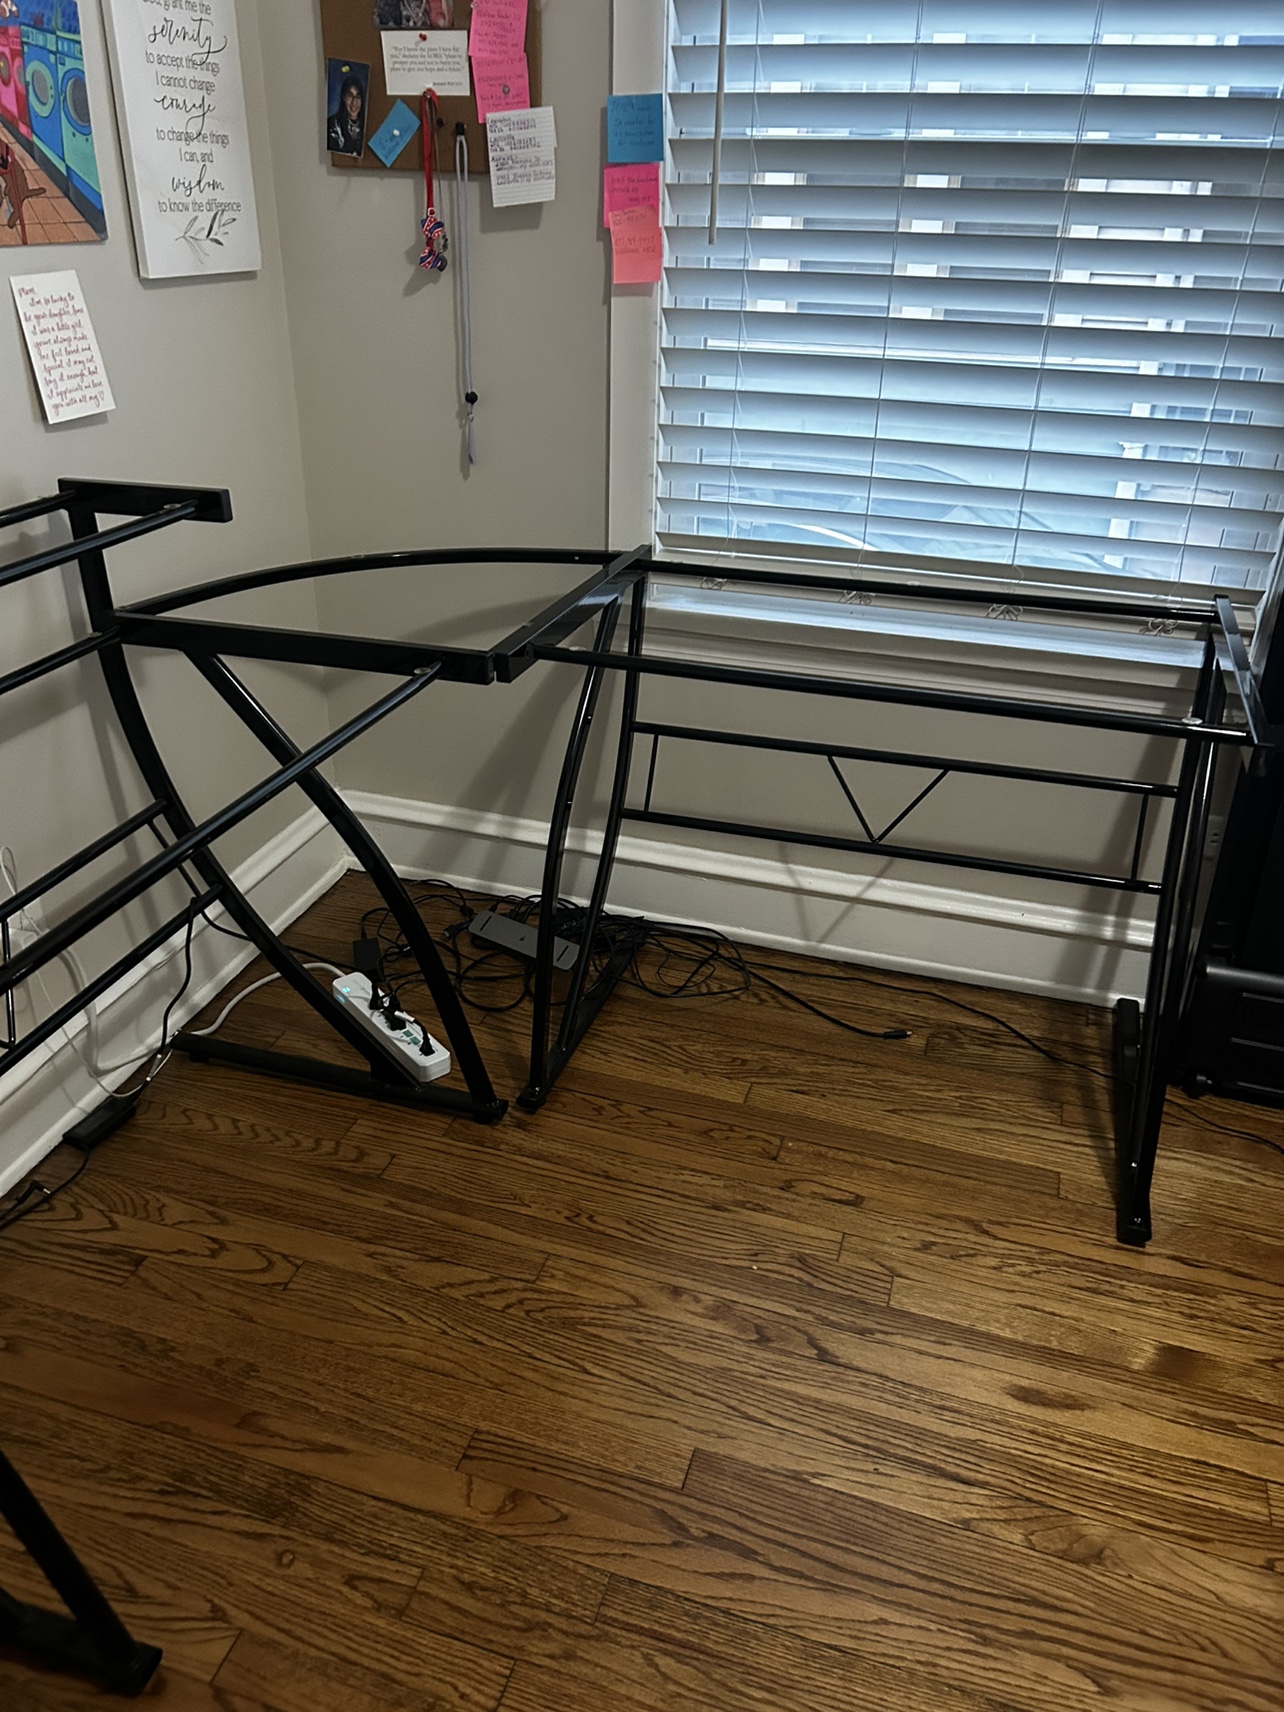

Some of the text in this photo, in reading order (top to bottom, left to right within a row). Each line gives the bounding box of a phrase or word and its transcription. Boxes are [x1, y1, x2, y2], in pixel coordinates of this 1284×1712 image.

[185, 1, 198, 13] me
[199, 2, 212, 15] the
[148, 17, 227, 66] serenity
[145, 50, 220, 77] to accept the things
[155, 70, 216, 96] I cannot change
[154, 95, 216, 139] courage
[156, 126, 230, 148] to change the things
[179, 147, 214, 163] I can, and
[171, 164, 225, 197] wisdom
[158, 198, 242, 213] to know the difference
[50, 294, 69, 308] lucky
[64, 344, 80, 356] loved
[81, 343, 92, 352] and
[73, 359, 87, 371] may
[52, 402, 64, 416] you
[79, 394, 88, 403] all
[89, 394, 100, 408] my
